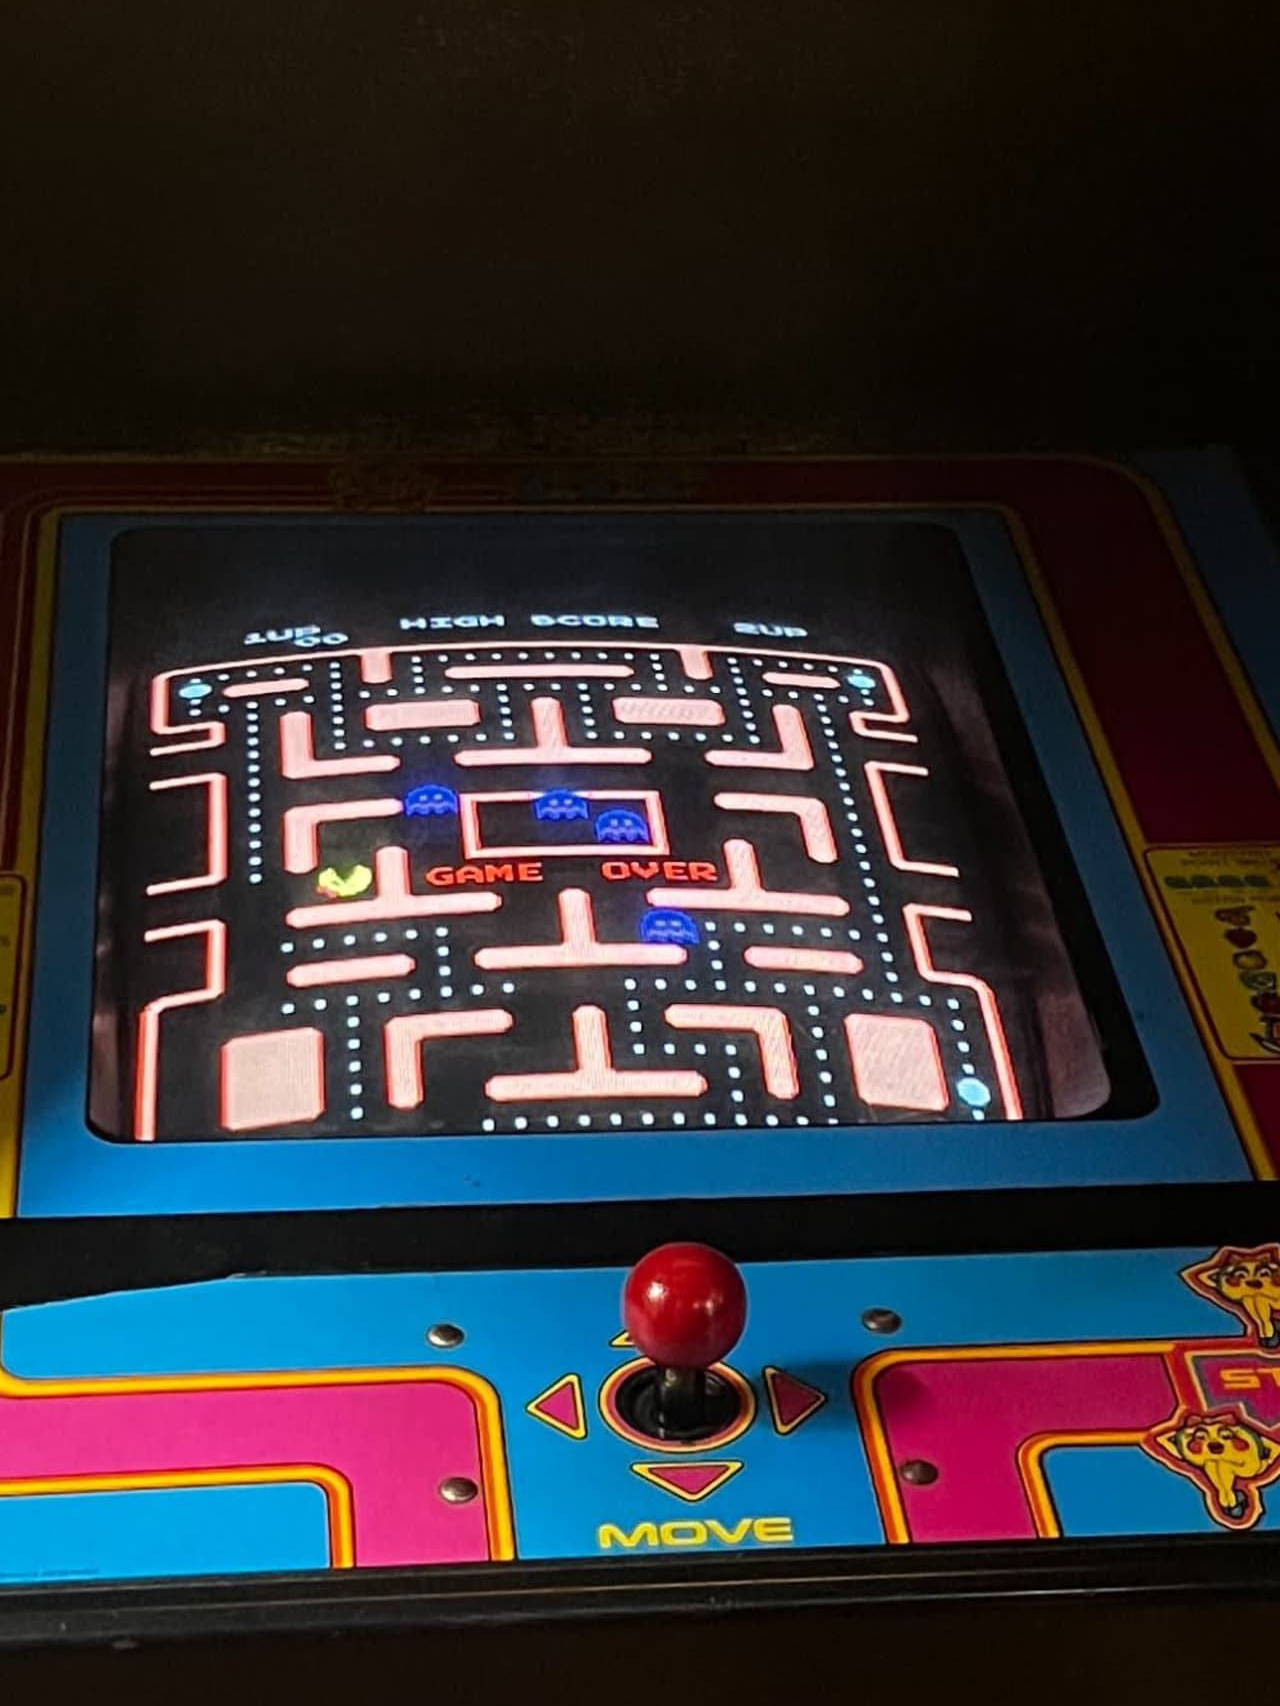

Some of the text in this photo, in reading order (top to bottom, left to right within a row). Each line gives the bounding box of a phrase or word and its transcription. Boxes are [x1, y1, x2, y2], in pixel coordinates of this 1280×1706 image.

[399, 614, 660, 630] HIGH SCORE
[733, 621, 808, 638] 2UP
[425, 860, 718, 886] GAME OVER
[599, 1517, 793, 1549] MOVE
